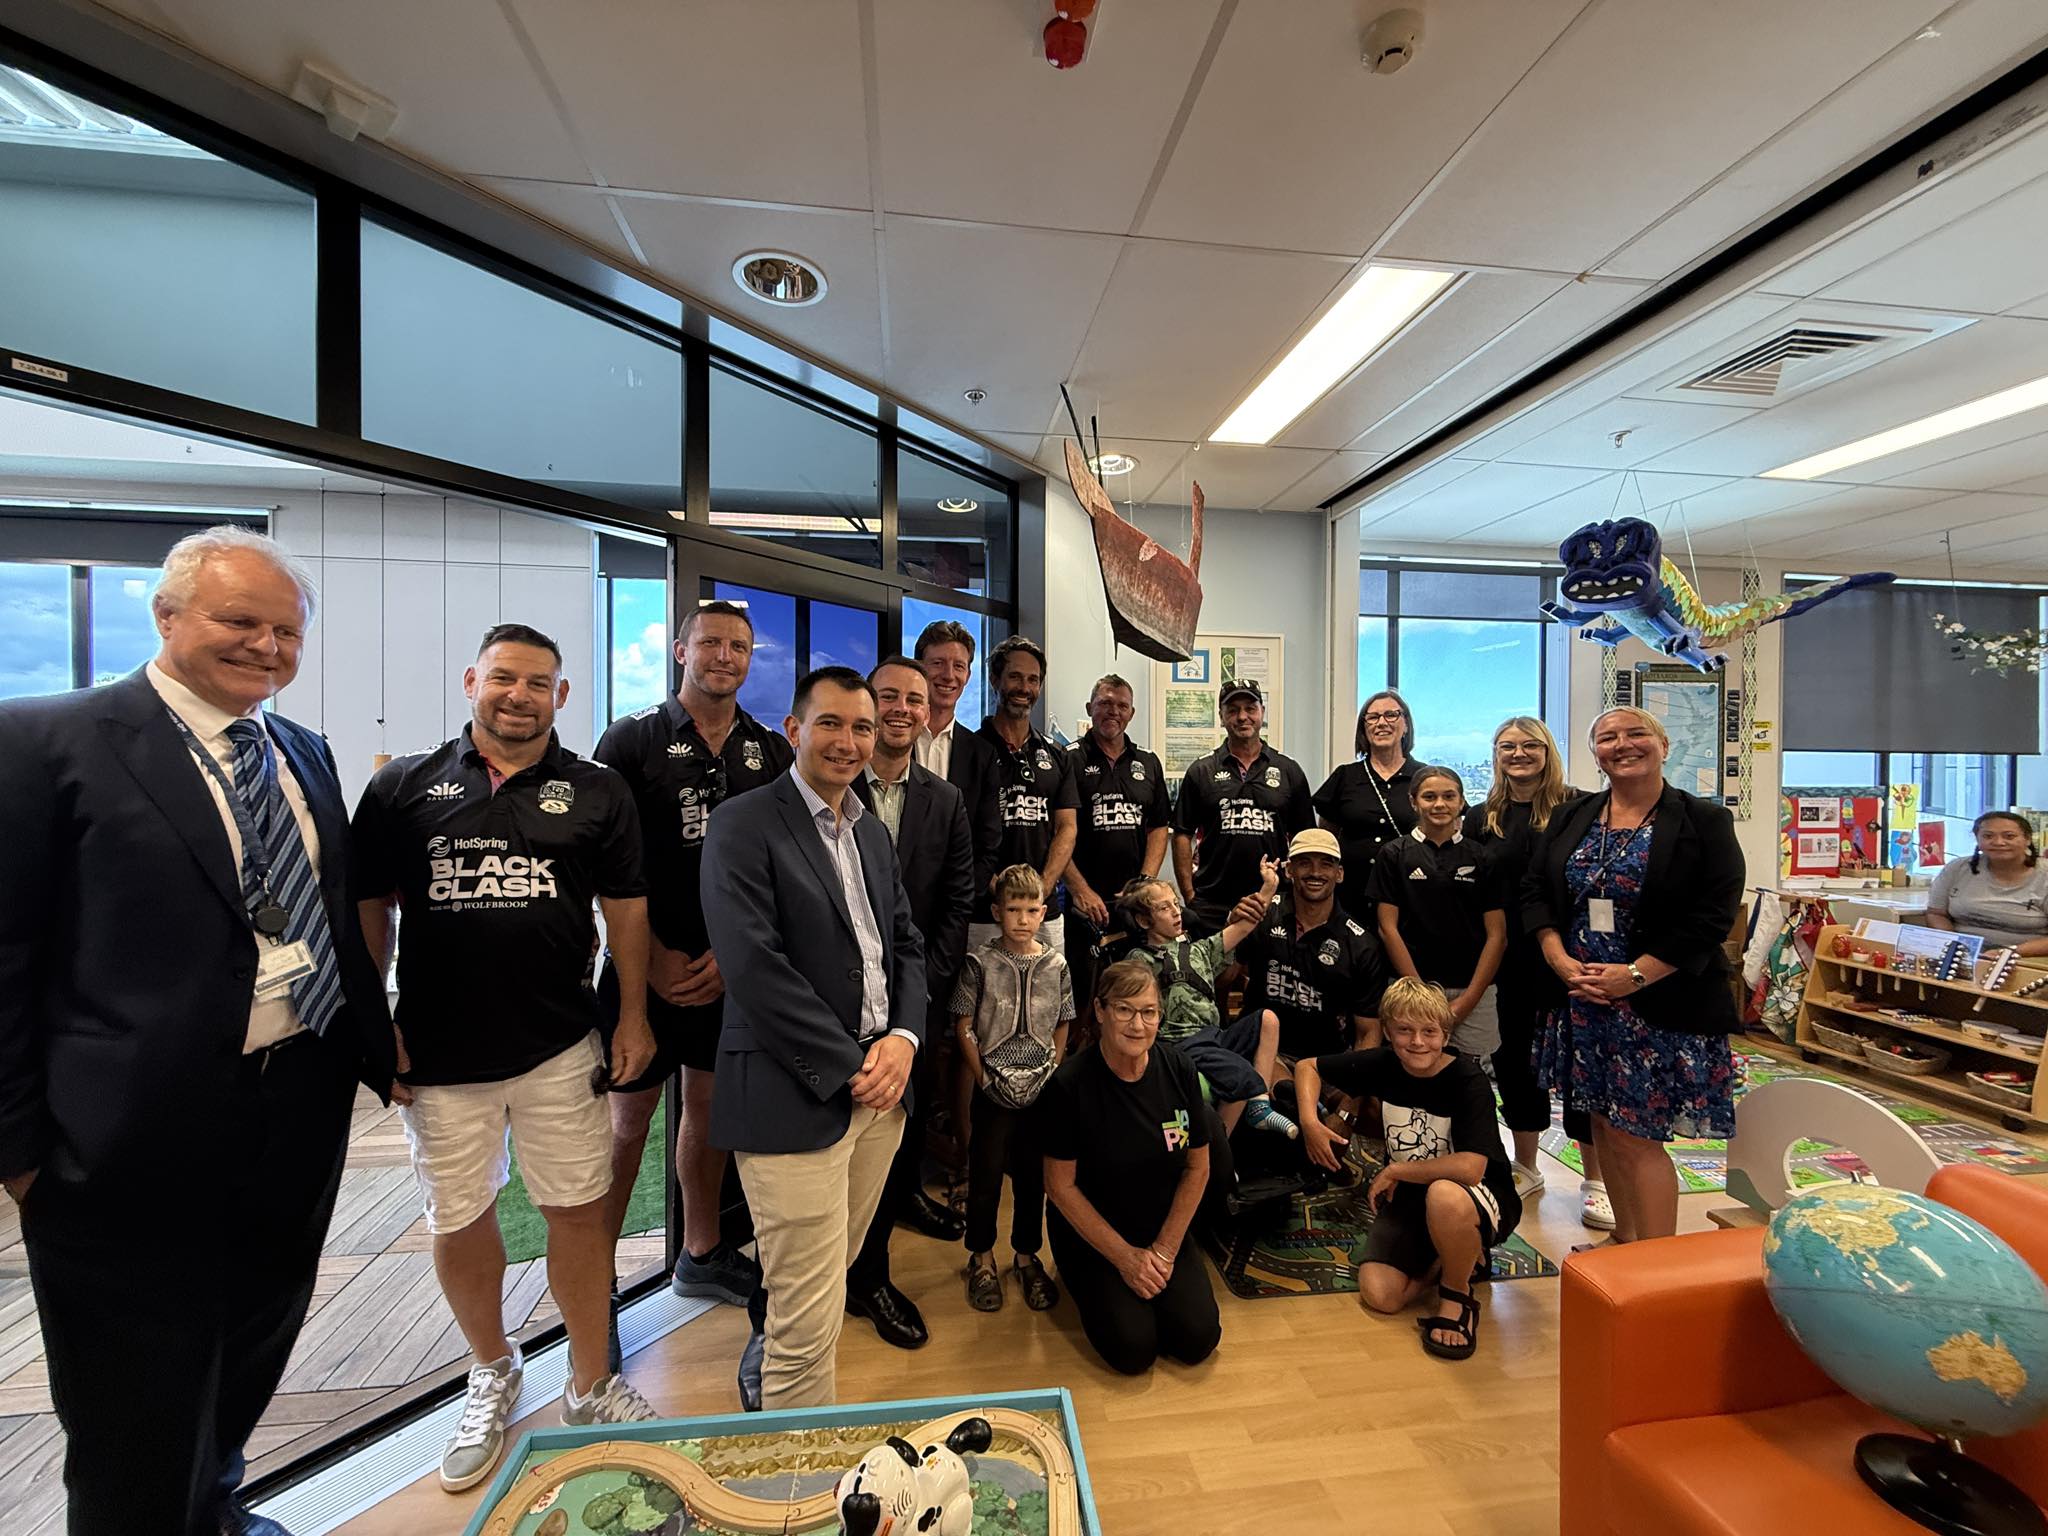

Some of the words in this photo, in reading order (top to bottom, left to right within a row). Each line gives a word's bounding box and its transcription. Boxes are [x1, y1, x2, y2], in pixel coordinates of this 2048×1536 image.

[1000, 795, 1049, 809] LACK
[1092, 802, 1143, 816] BLACK
[1000, 807, 1049, 822] LASH
[1220, 807, 1276, 822] BLACK
[1221, 818, 1274, 833] CLASH
[454, 837, 508, 850] HotSpring
[430, 855, 556, 880] BLACK
[428, 877, 558, 901] CLASH
[464, 901, 529, 910] WOLFBROOK
